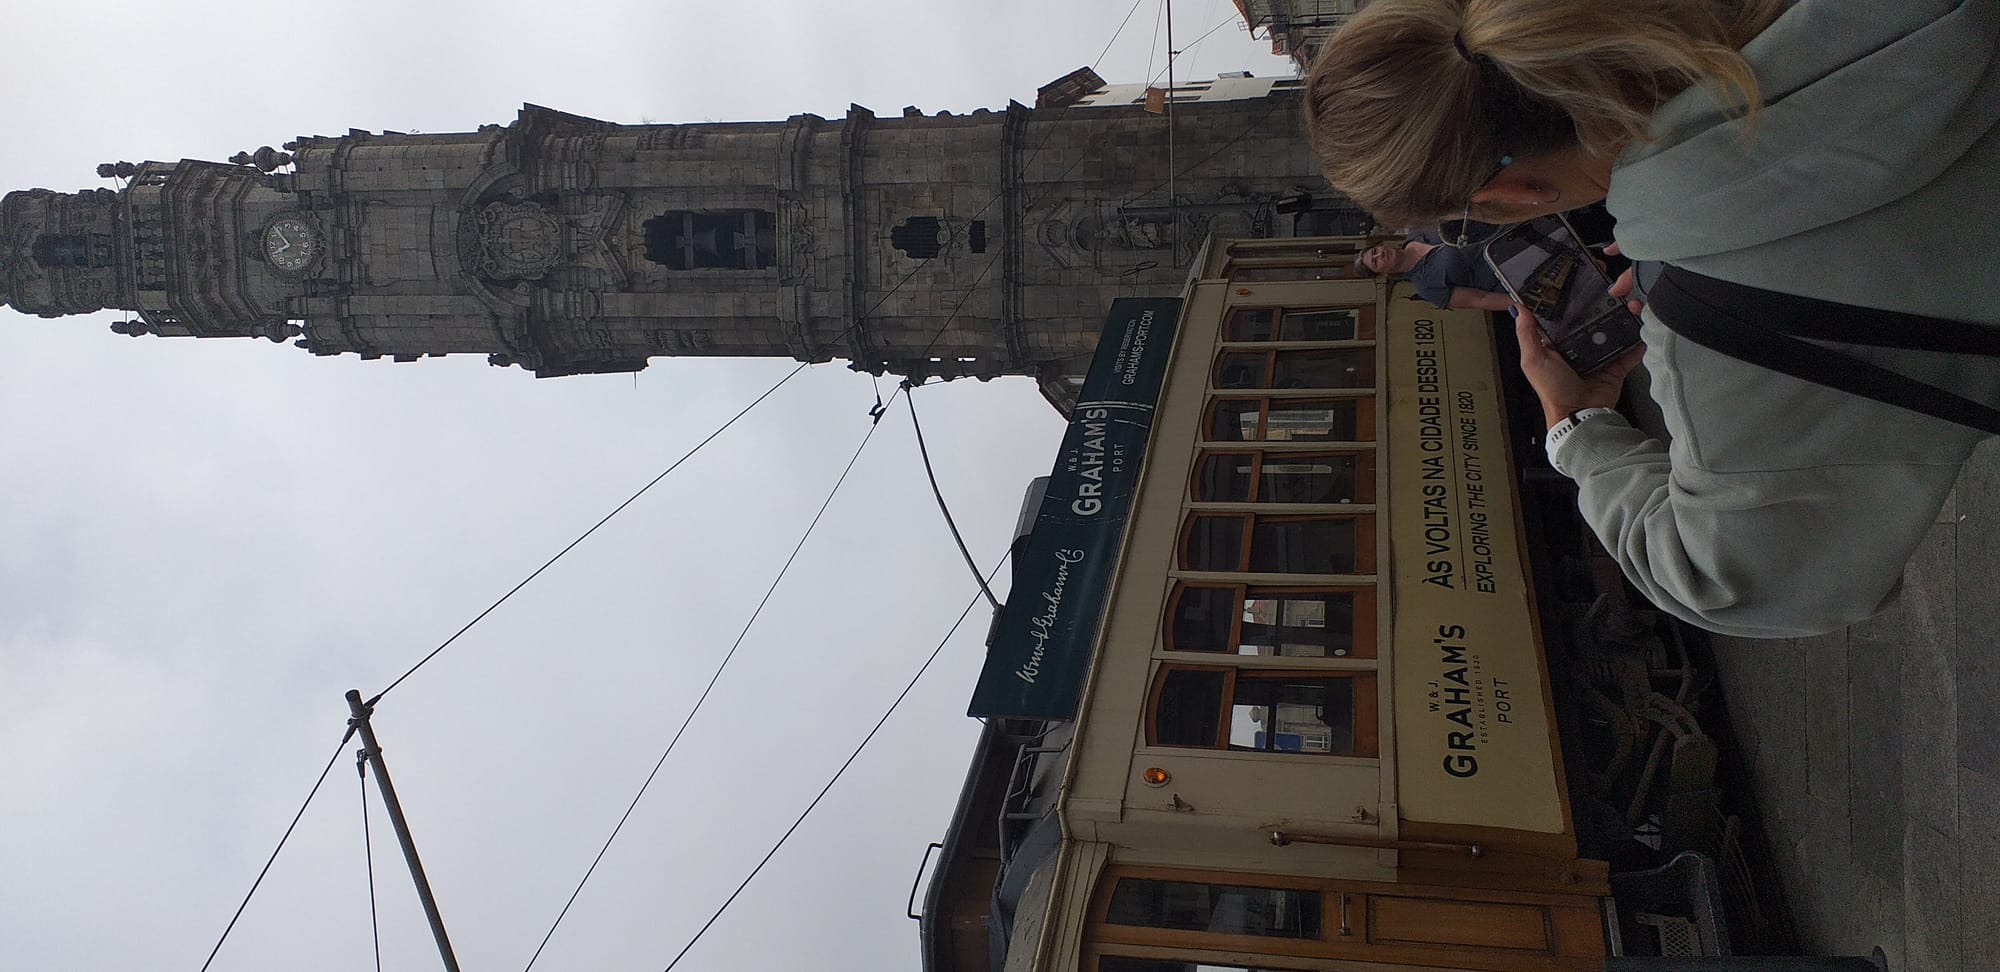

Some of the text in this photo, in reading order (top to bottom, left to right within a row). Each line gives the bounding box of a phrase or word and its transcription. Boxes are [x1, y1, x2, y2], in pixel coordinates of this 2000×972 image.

[270, 241, 276, 249] 12
[279, 257, 285, 265] 10
[1118, 350, 1127, 358] BY
[1121, 310, 1155, 385] GRAHAMS-PORT.COM
[1112, 443, 1124, 473] PORT
[1414, 319, 1454, 589] ÀS VOLTAS NA CIDADE DESDE 1820
[1457, 391, 1496, 593] EXPLORING THE CITY SINCE 1820
[1428, 679, 1438, 688] J.
[1429, 701, 1440, 712] W.
[1472, 654, 1489, 744] ESTABLISHED 1820
[1493, 677, 1513, 724] PORT
